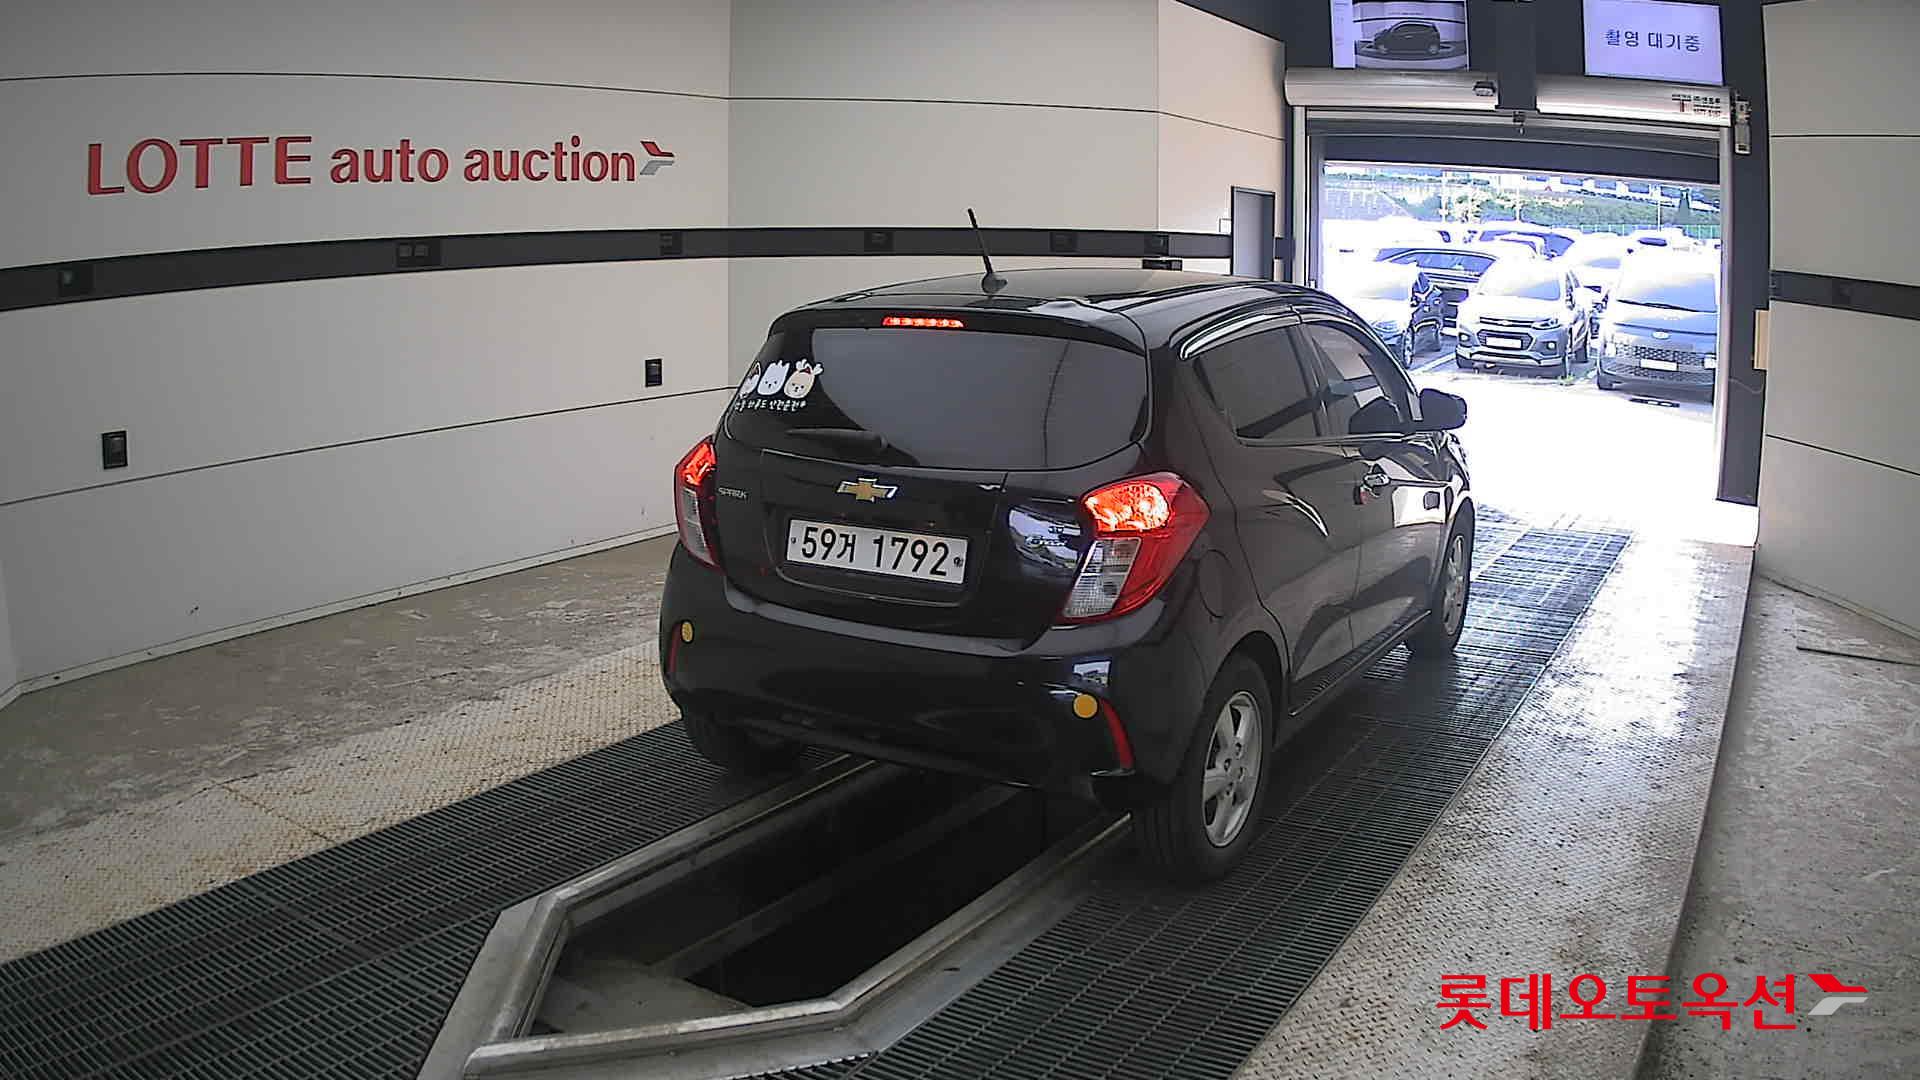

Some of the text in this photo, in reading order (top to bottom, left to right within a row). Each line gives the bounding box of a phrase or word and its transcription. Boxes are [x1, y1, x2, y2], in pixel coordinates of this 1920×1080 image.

[1647, 32, 1701, 53] 대기중
[87, 136, 636, 194] LOTTE auto auction
[801, 526, 950, 577] 59거 1792
